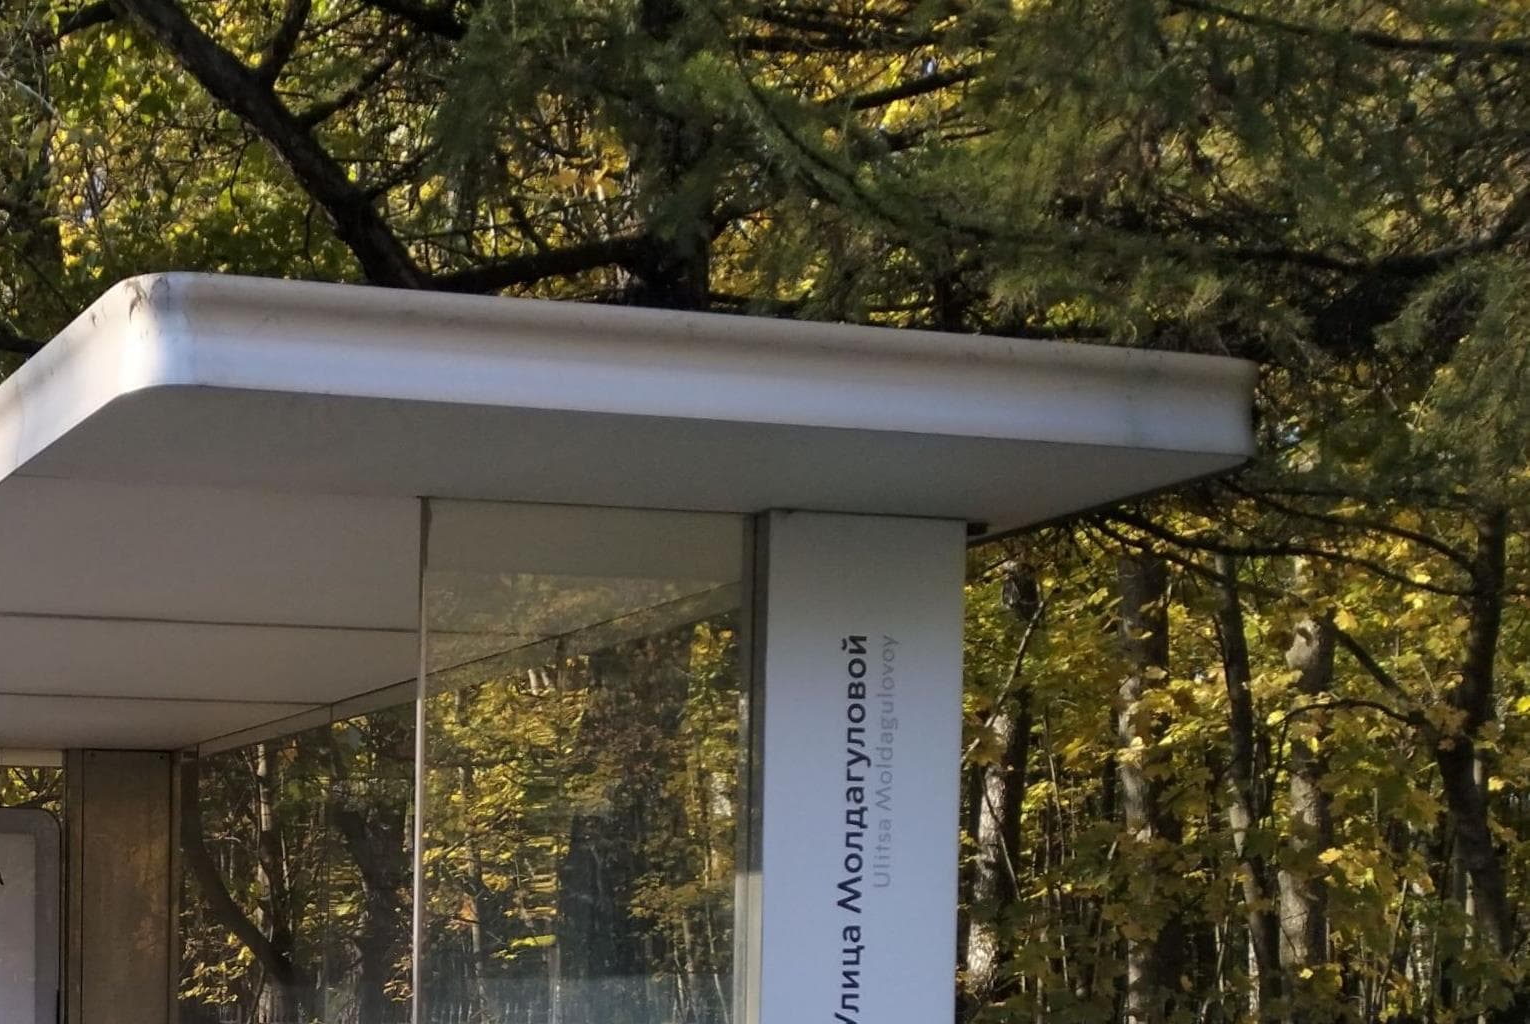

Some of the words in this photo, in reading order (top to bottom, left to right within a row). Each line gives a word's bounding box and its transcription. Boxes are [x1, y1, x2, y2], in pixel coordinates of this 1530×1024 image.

[837, 634, 871, 914] Молдагуловой
[873, 634, 900, 811] Moldagulovoy
[872, 818, 894, 888] Ulitsa
